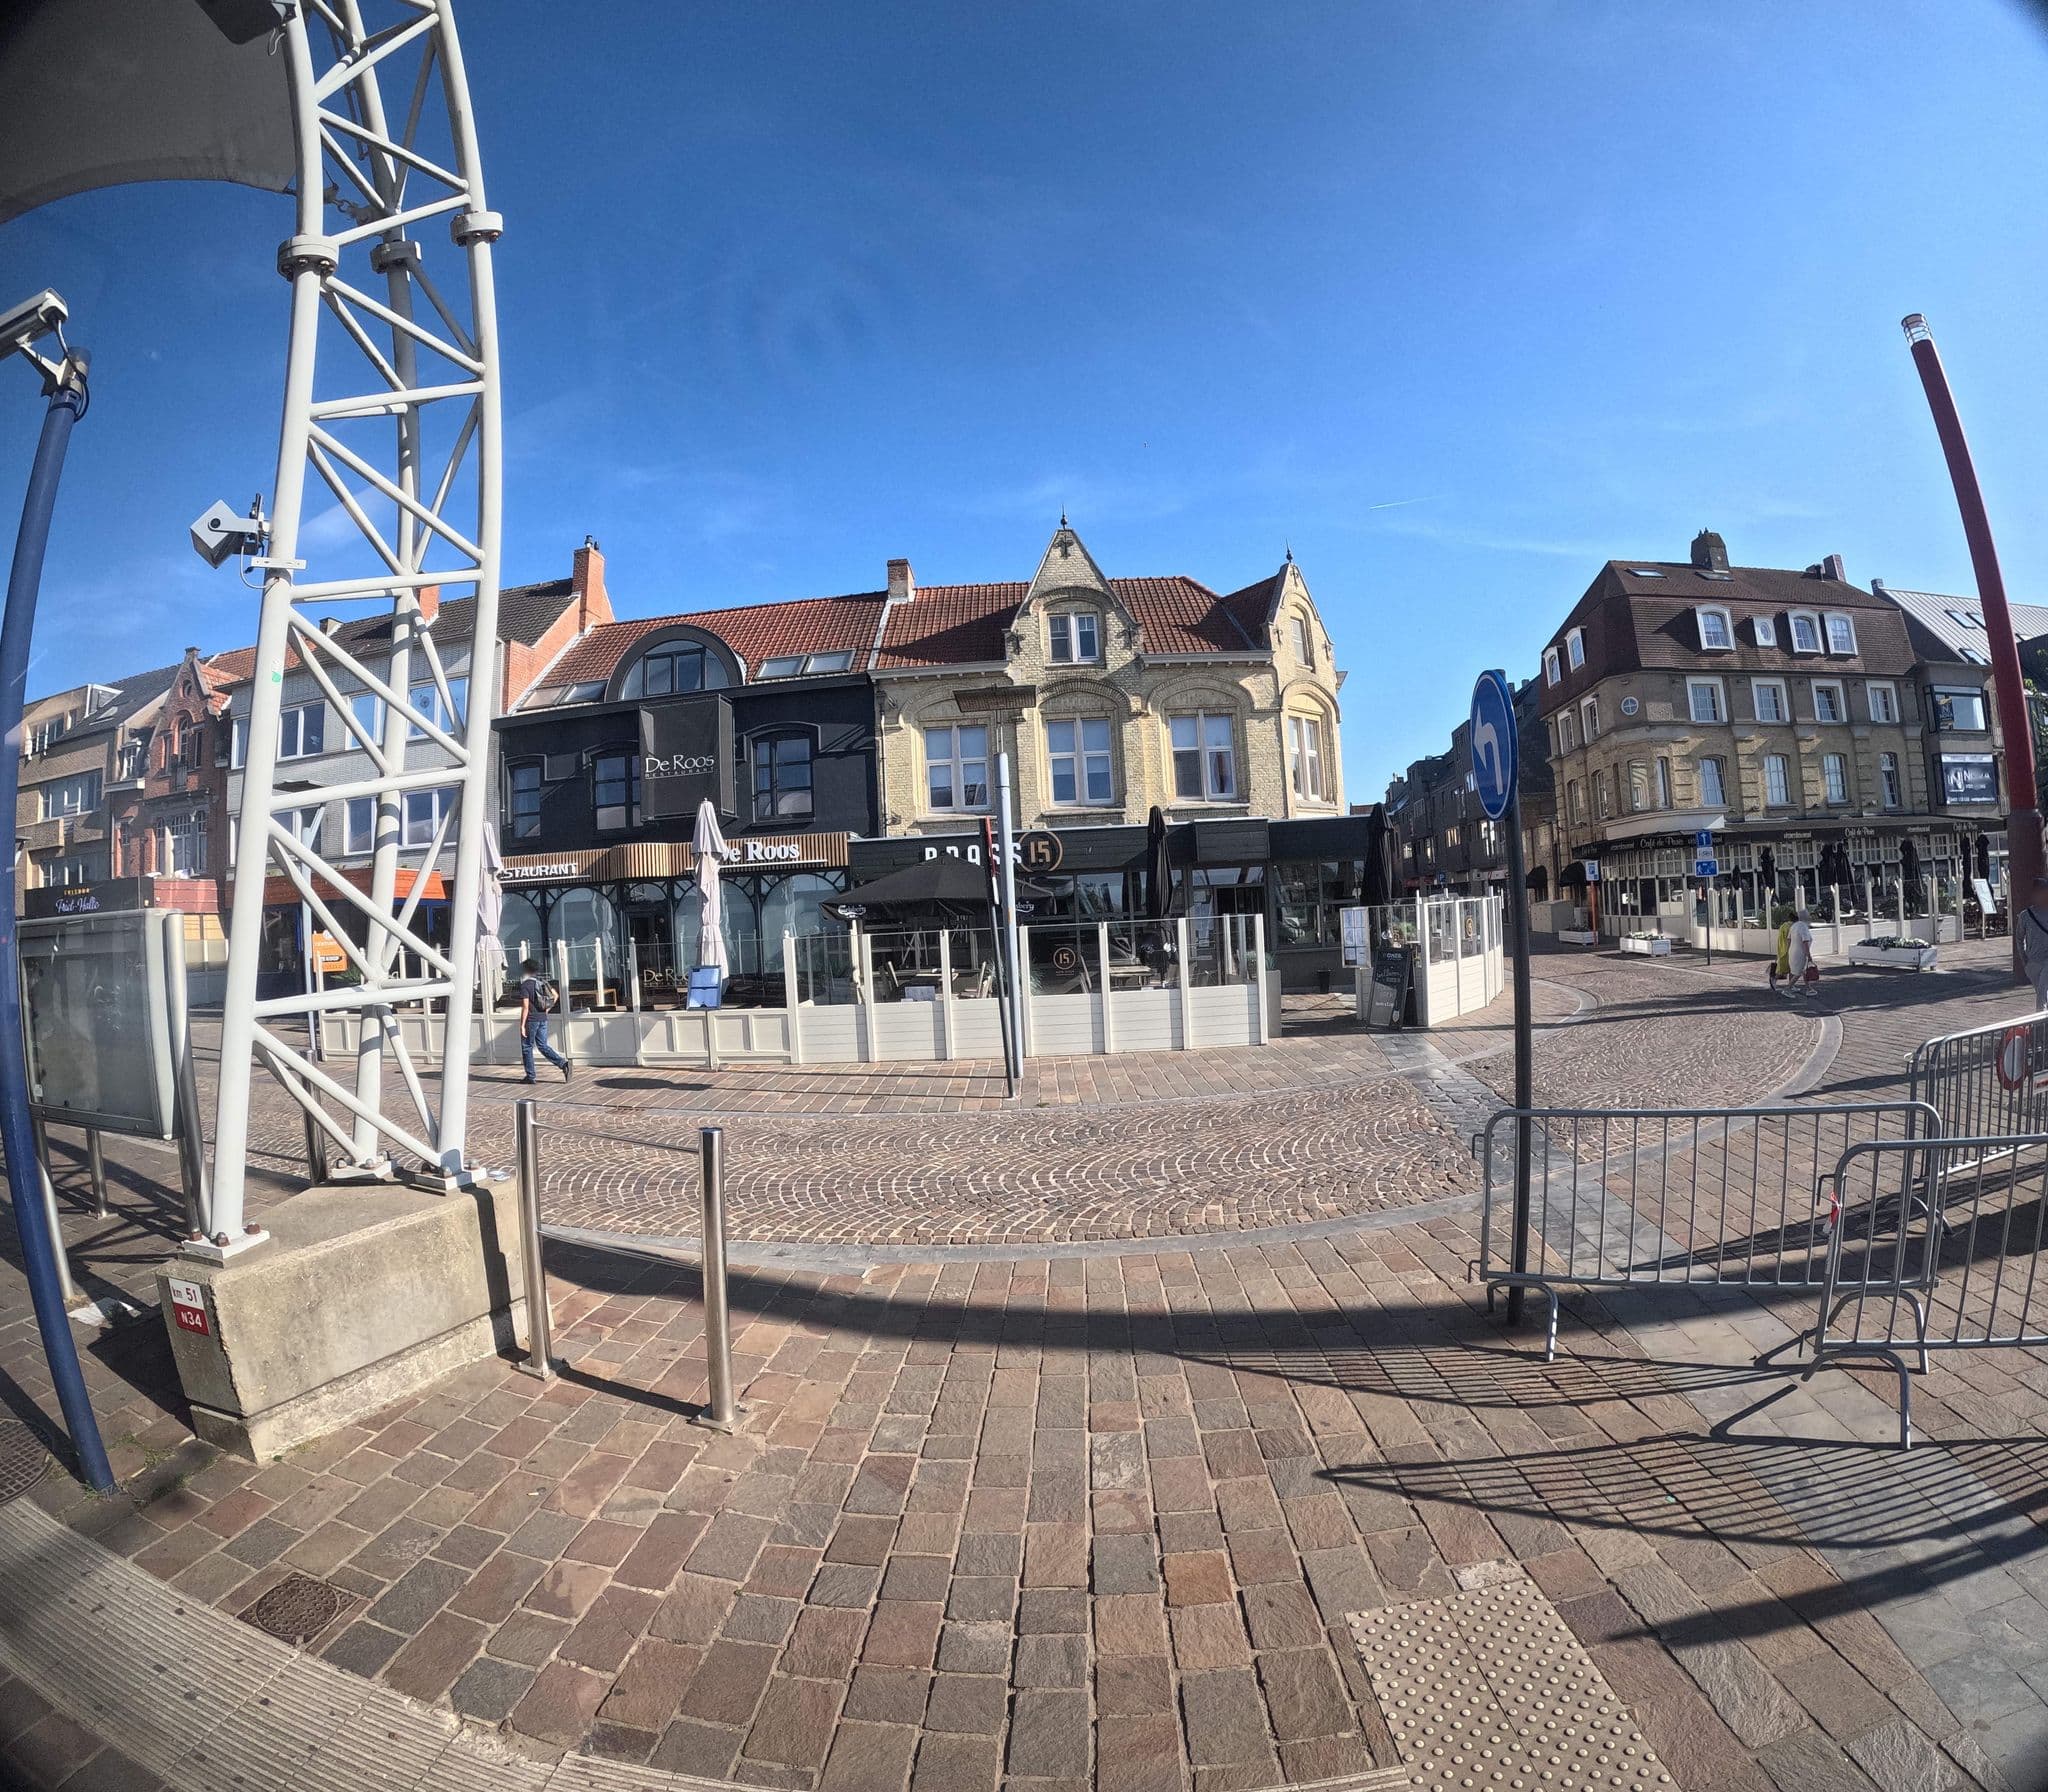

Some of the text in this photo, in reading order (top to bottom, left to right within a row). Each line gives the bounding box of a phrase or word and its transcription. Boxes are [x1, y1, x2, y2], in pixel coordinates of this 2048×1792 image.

[645, 754, 715, 773] De Roos
[745, 841, 800, 861] Roos
[1029, 840, 1051, 863] 15
[643, 969, 663, 983] De
[171, 1286, 198, 1304] km 51
[180, 1311, 203, 1328] N34
